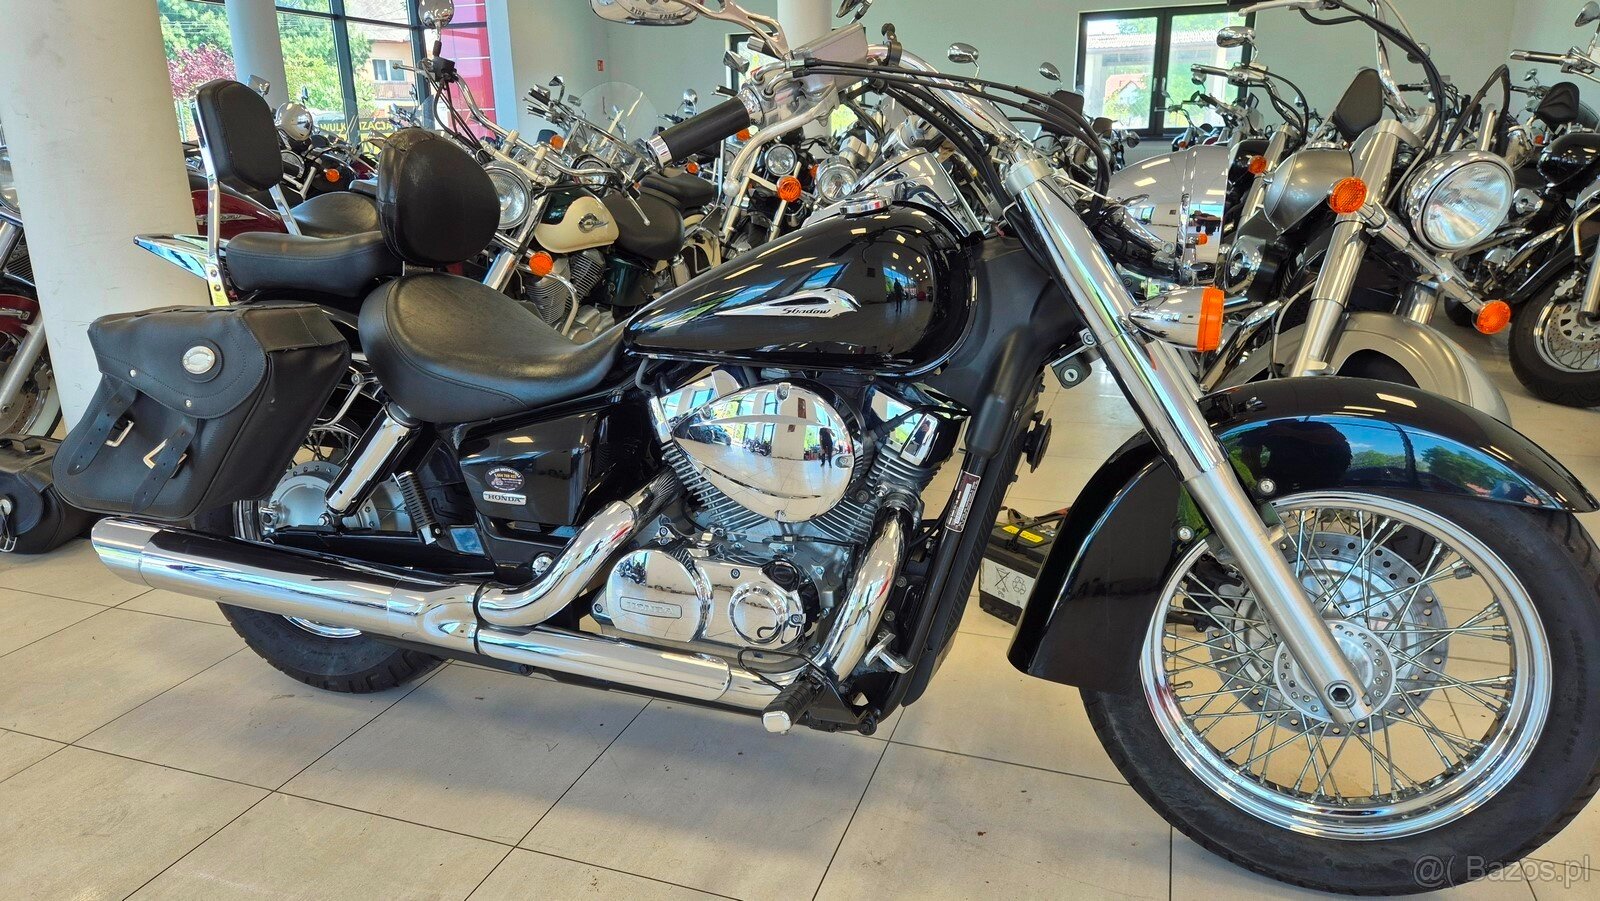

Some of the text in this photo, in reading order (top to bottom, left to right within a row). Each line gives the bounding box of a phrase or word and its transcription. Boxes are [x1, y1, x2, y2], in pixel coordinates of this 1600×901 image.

[320, 121, 393, 132] WULKIZACJA
[782, 306, 832, 315] Shadow
[488, 494, 521, 503] HONDA
